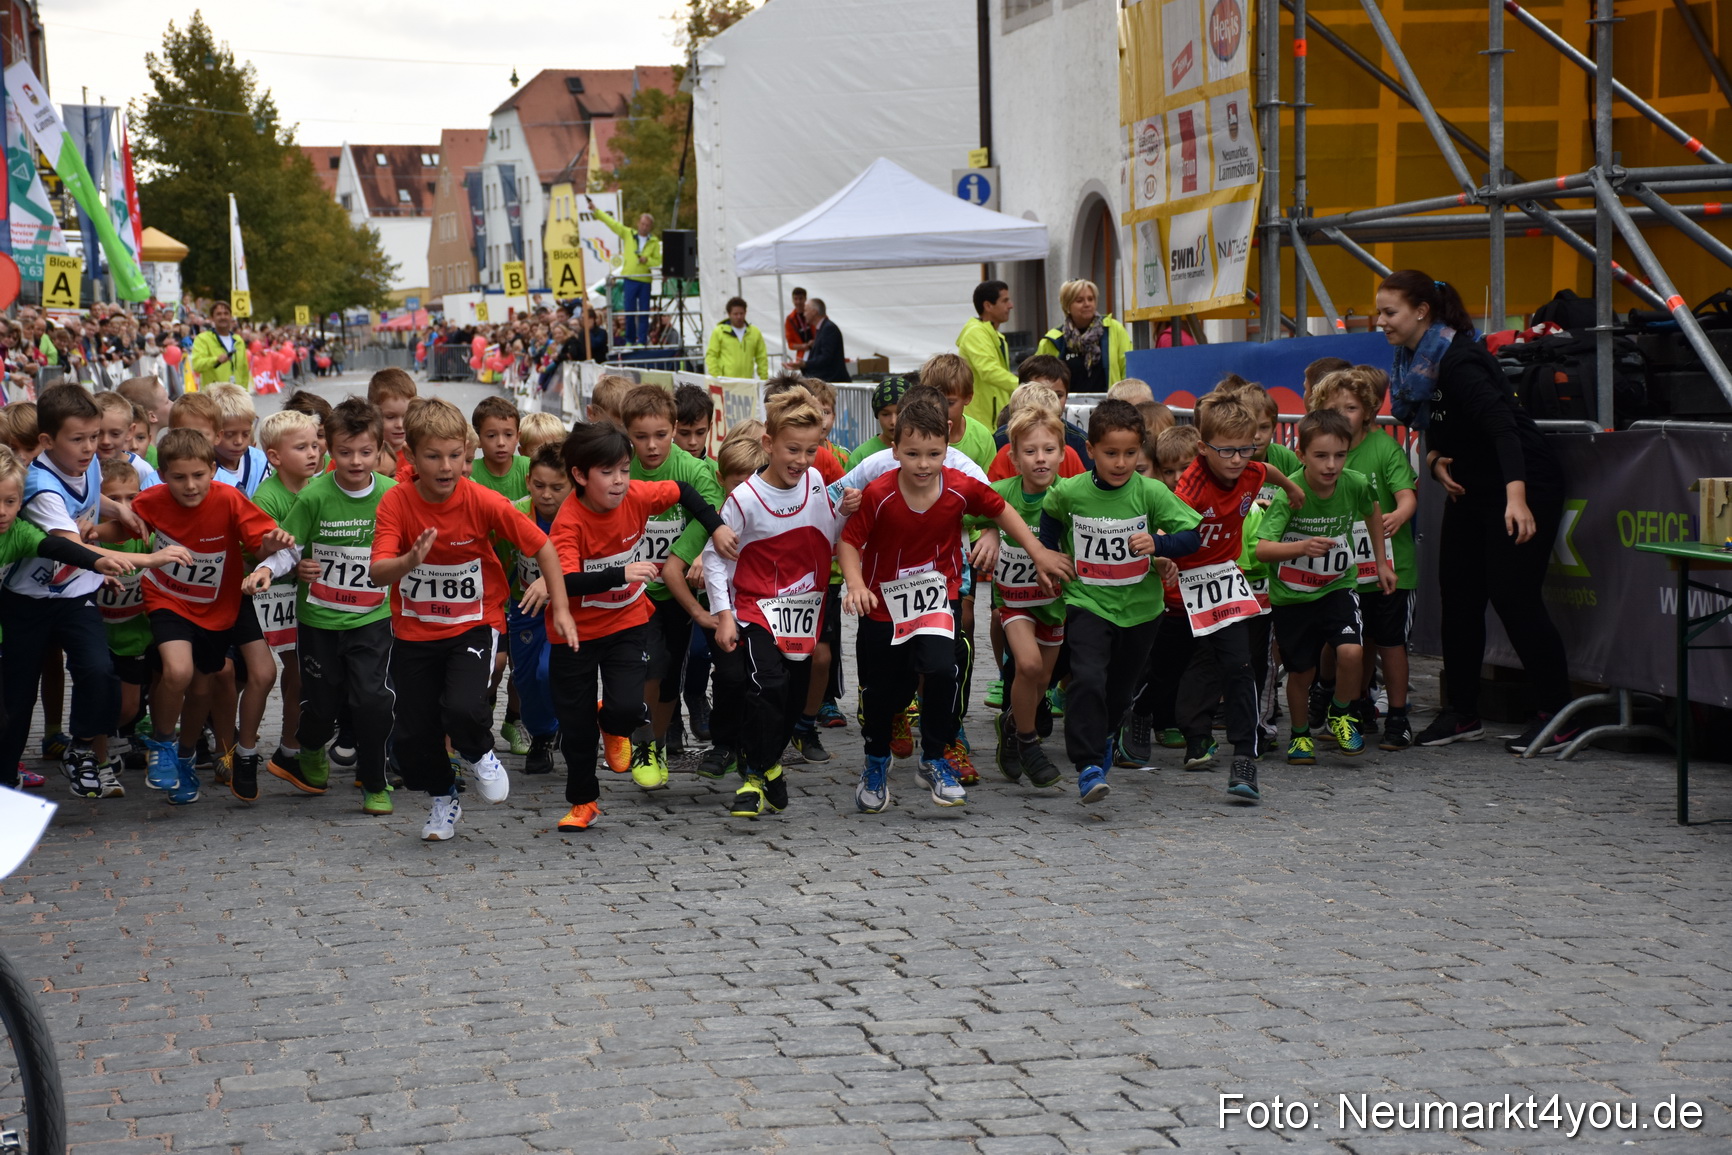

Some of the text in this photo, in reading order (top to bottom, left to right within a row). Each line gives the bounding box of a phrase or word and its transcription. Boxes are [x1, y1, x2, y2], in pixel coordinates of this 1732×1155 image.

[1213, 13, 1239, 43] Hervis
[1221, 146, 1249, 161] Neumarkter
[1218, 158, 1255, 182] Lammsbräu
[553, 250, 580, 260] Block
[1171, 246, 1195, 271] swn
[50, 257, 78, 269] Block
[509, 273, 522, 289] B
[559, 263, 578, 288] A
[51, 272, 72, 297] A
[236, 298, 245, 311] C
[319, 518, 372, 528] Neumarkter
[1292, 516, 1338, 524] Neumarkter
[319, 528, 362, 537] Stadtlauf
[1074, 521, 1135, 534] PARTL Neumarkt
[1290, 522, 1328, 532] Stadtlauf
[1616, 509, 1690, 548] OFFICE
[314, 548, 339, 558] PARTL
[1080, 533, 1138, 562] 743
[428, 569, 468, 577] Neumarkt
[1000, 558, 1038, 584] 722
[1180, 564, 1237, 585] PARTL Neumarkt
[166, 578, 190, 593] Leon
[1301, 573, 1330, 585] Lukas
[407, 575, 477, 599] 7188
[883, 583, 910, 595] PARTL
[1188, 573, 1250, 609] 7073
[254, 592, 272, 601] PARTL
[335, 592, 357, 604] Luis
[611, 590, 631, 602] Luis
[785, 597, 814, 606] Neumarkt
[260, 600, 297, 628] 744
[430, 604, 451, 615] Erik
[1211, 605, 1242, 622] Simon
[771, 607, 815, 634] 7076
[785, 640, 803, 651] Simon
